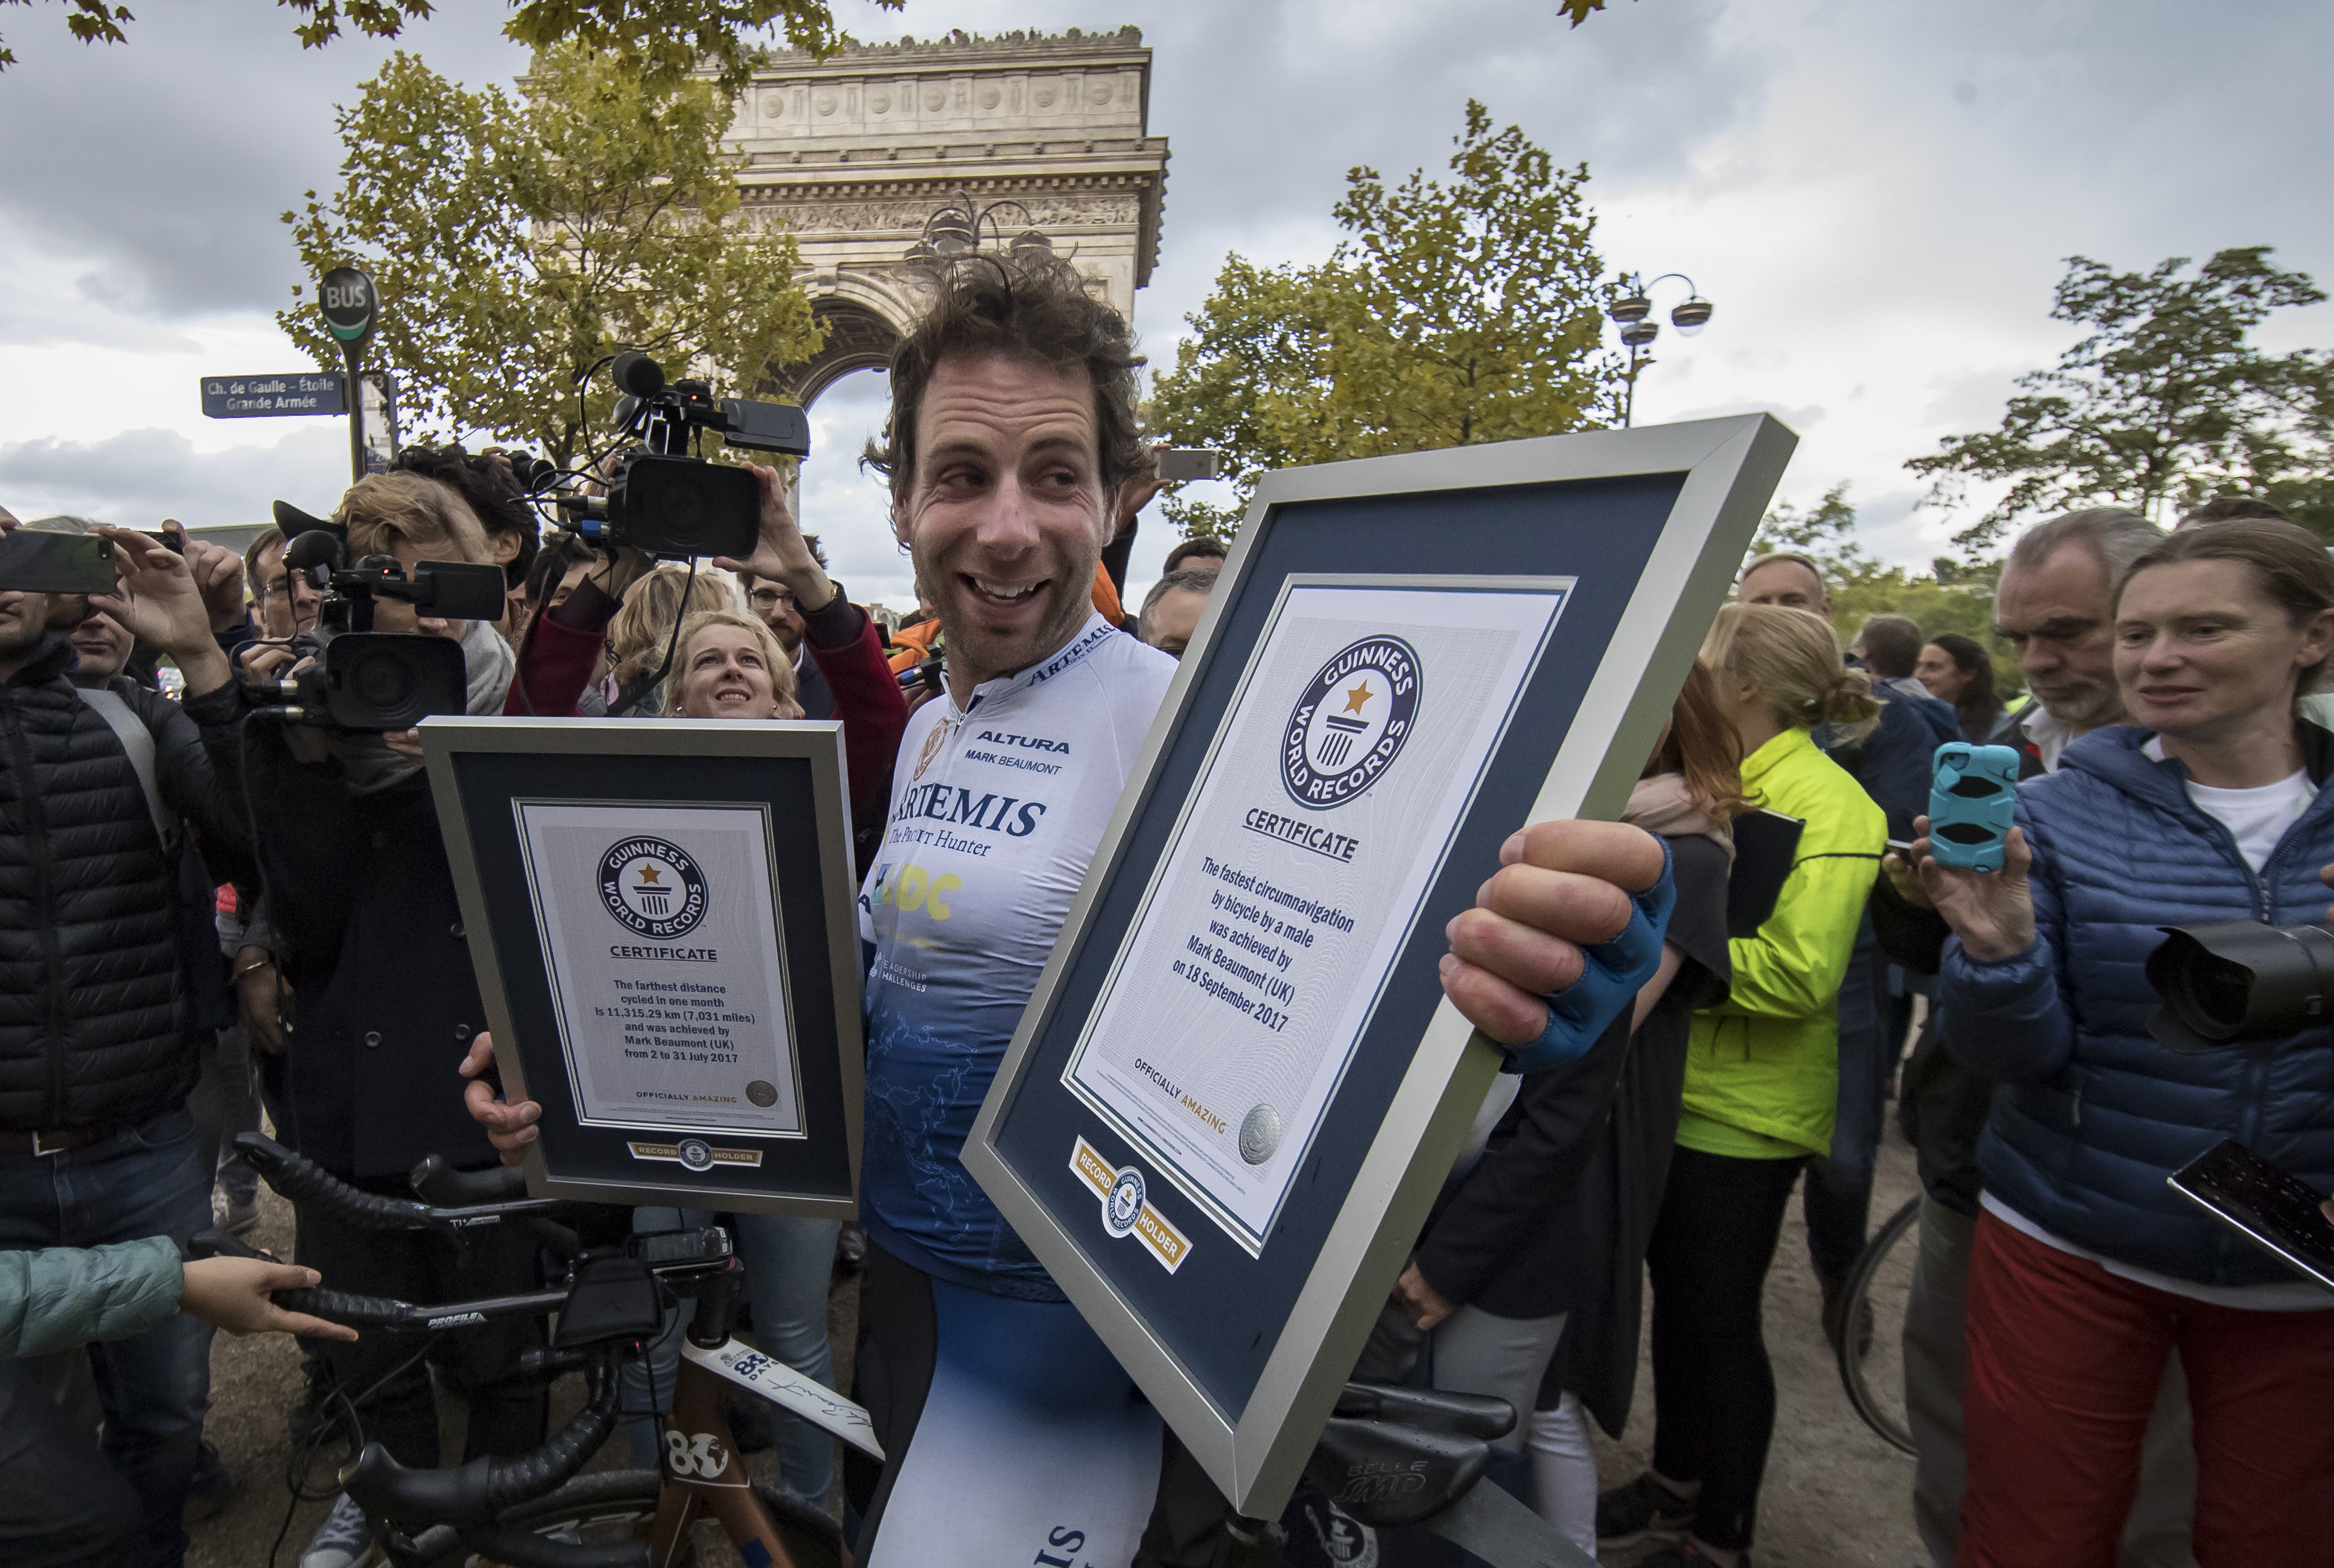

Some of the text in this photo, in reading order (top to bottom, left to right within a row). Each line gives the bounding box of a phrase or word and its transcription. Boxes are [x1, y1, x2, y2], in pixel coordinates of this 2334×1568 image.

[327, 286, 366, 309] BUS
[208, 382, 227, 395] Ch.
[231, 381, 245, 394] de
[249, 380, 287, 394] Gaulle
[299, 376, 335, 392] Étoile
[226, 394, 317, 410] Grande Armée
[1028, 624, 1115, 687] ARTEMIS
[1324, 646, 1413, 696] GUINNESS
[977, 731, 1069, 754] ALTURA
[1288, 705, 1405, 799] WORLD RECORDS
[965, 749, 1062, 775] MARK BEAUMONT
[892, 779, 1047, 837] ARTEMIS
[889, 828, 902, 844] The
[934, 830, 991, 857] Hunter
[1245, 808, 1359, 860] CERTIFICATE
[610, 843, 689, 871] GUINNESS
[604, 882, 701, 934] WORLD RECORDS
[1202, 856, 1354, 933] The fastest circumnavigation
[1211, 889, 1314, 948] by bicycle by a male
[610, 946, 717, 960] CERTIFICATE
[1209, 920, 1293, 972] was achieved by
[1187, 935, 1295, 1007] Mark Beaumont (UK)
[614, 980, 726, 993] The farthest distance
[1173, 960, 1289, 1032] on 18 September 2017
[621, 995, 653, 1005] cycled
[656, 996, 666, 1005] in
[690, 998, 724, 1007] month
[607, 1007, 661, 1019] 11,315.29
[665, 1010, 681, 1020] km
[683, 1011, 719, 1022] (7,031
[723, 1013, 755, 1025] miles)
[625, 1022, 644, 1032] and
[669, 1025, 715, 1035] achieved
[718, 1027, 730, 1037] by
[624, 1035, 734, 1051] Mark Beaumont (UK)
[625, 1049, 738, 1063] from 2 to 31 July 2017
[636, 1091, 689, 1100] OFFICIALLY
[1135, 1058, 1181, 1099] OFFICIALLY
[1181, 1095, 1227, 1135] AMAZING
[639, 1147, 753, 1161] RECORD HOLDER
[1121, 1176, 1142, 1200] GUINNESS
[1080, 1153, 1178, 1258] RECORD HOLDER
[1110, 1188, 1139, 1228] WORLD RECORDS
